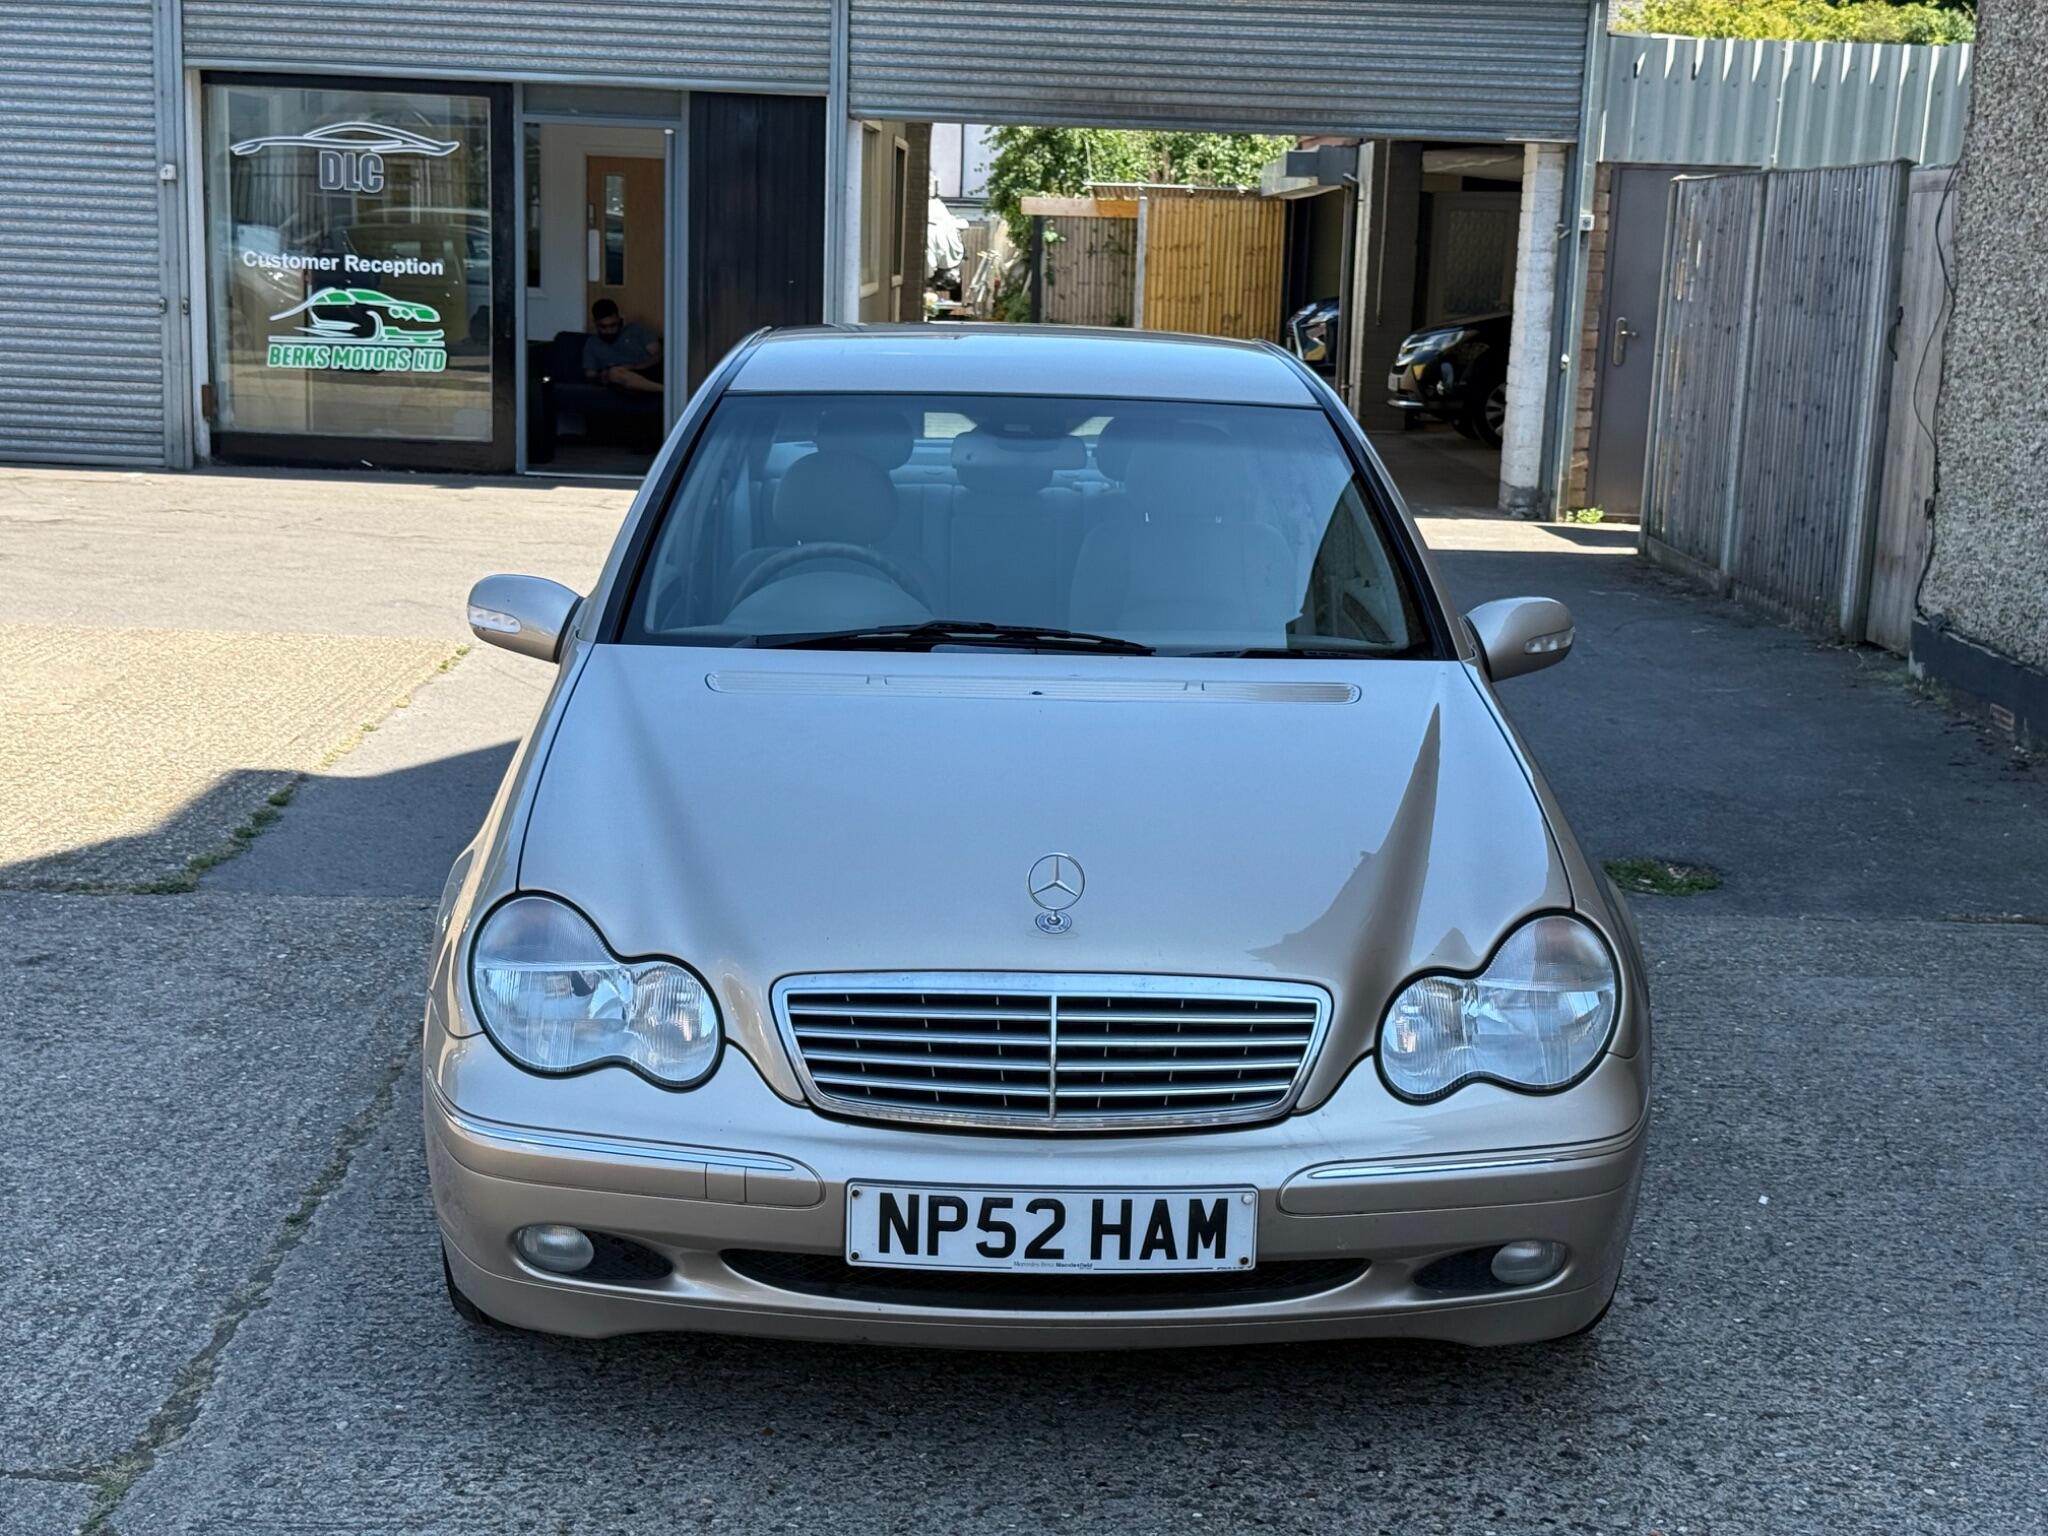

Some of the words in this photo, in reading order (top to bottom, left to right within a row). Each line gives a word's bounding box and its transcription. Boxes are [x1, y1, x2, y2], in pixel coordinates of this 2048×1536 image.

[319, 151, 384, 193] DLC
[243, 251, 339, 271] Customer
[345, 254, 443, 277] Reception
[267, 344, 331, 369] BERKS
[330, 346, 412, 371] MOTORS
[411, 348, 447, 372] LTD
[878, 1192, 1067, 1259] NP52
[1090, 1198, 1229, 1260] HAM
